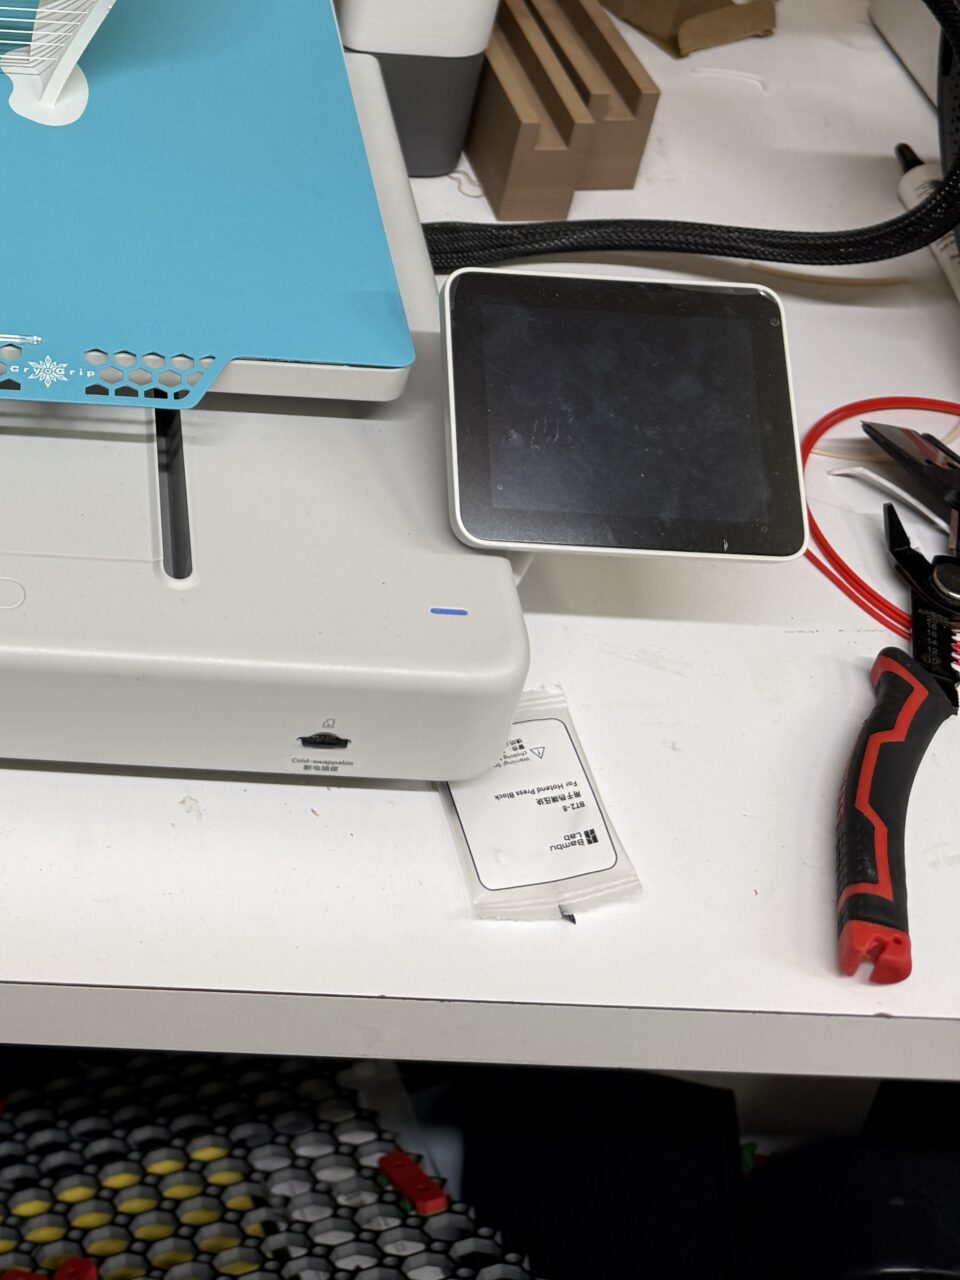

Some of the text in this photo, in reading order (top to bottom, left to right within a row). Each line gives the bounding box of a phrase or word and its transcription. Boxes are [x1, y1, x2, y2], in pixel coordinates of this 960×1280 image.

[291, 757, 354, 766] Cold-swappable
[515, 787, 537, 797] Press
[536, 783, 564, 794] Hotend
[494, 791, 515, 801] Block
[562, 801, 586, 812] BT2-8
[550, 831, 585, 851] Bambu Lab
